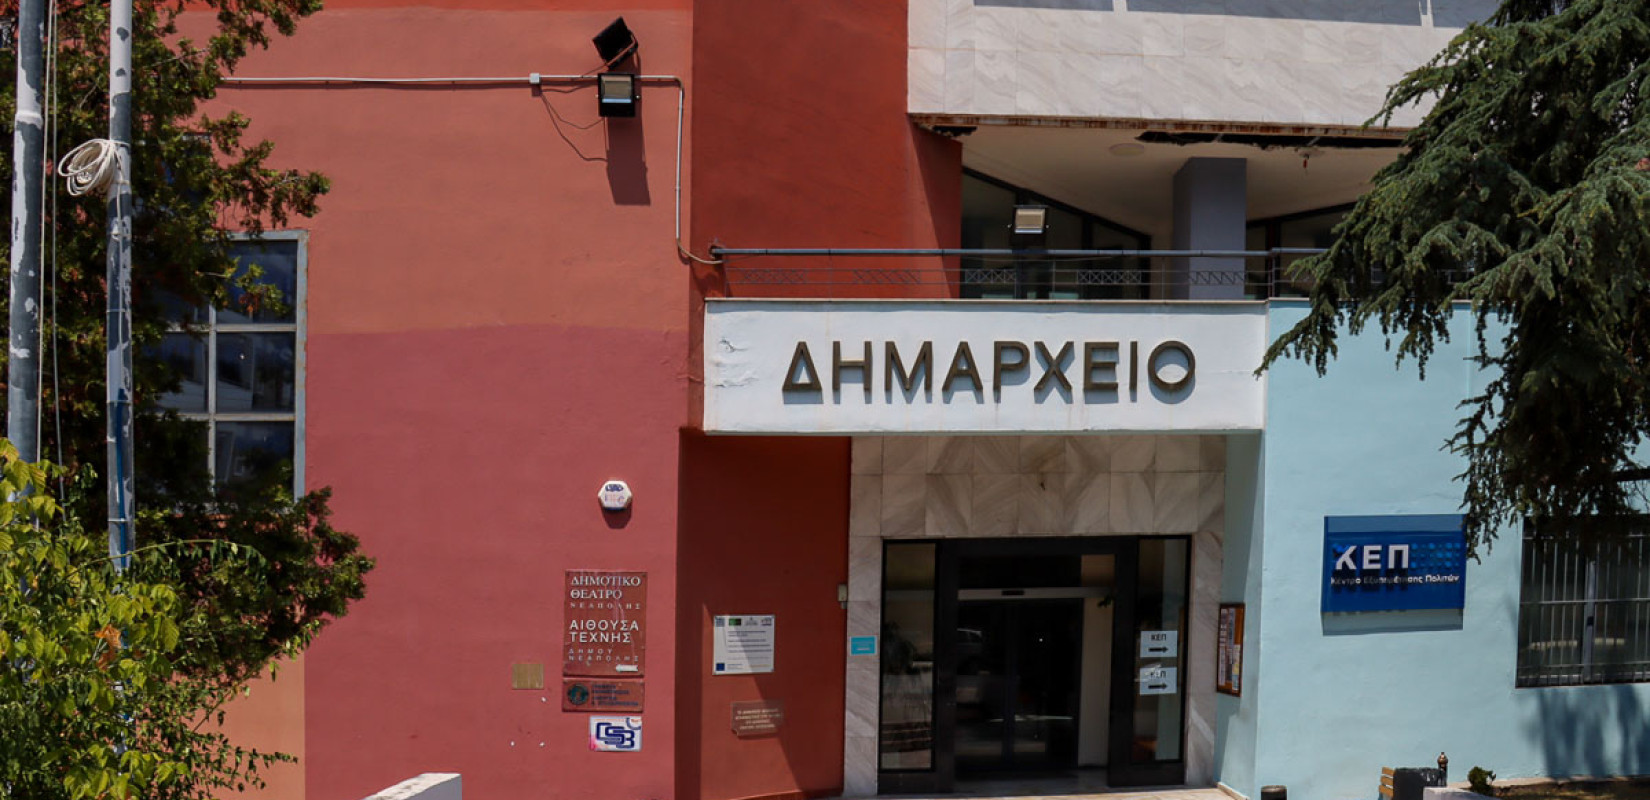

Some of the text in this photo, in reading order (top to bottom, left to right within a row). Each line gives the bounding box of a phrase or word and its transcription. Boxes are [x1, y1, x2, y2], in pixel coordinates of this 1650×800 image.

[782, 340, 1197, 393] ΔΗΜΑΡΧΕΙΟ
[1333, 543, 1409, 570] ΚΕΠ
[571, 575, 641, 587] ΔΗΜΟΤΙΚΟ
[1425, 573, 1460, 583] Πολιτών
[570, 589, 623, 599] ΘΕΑΤΡΟ
[569, 619, 639, 631] ΑΙΘΟΥΣΑ
[569, 631, 631, 643] ΤΕΧΝΗΣ
